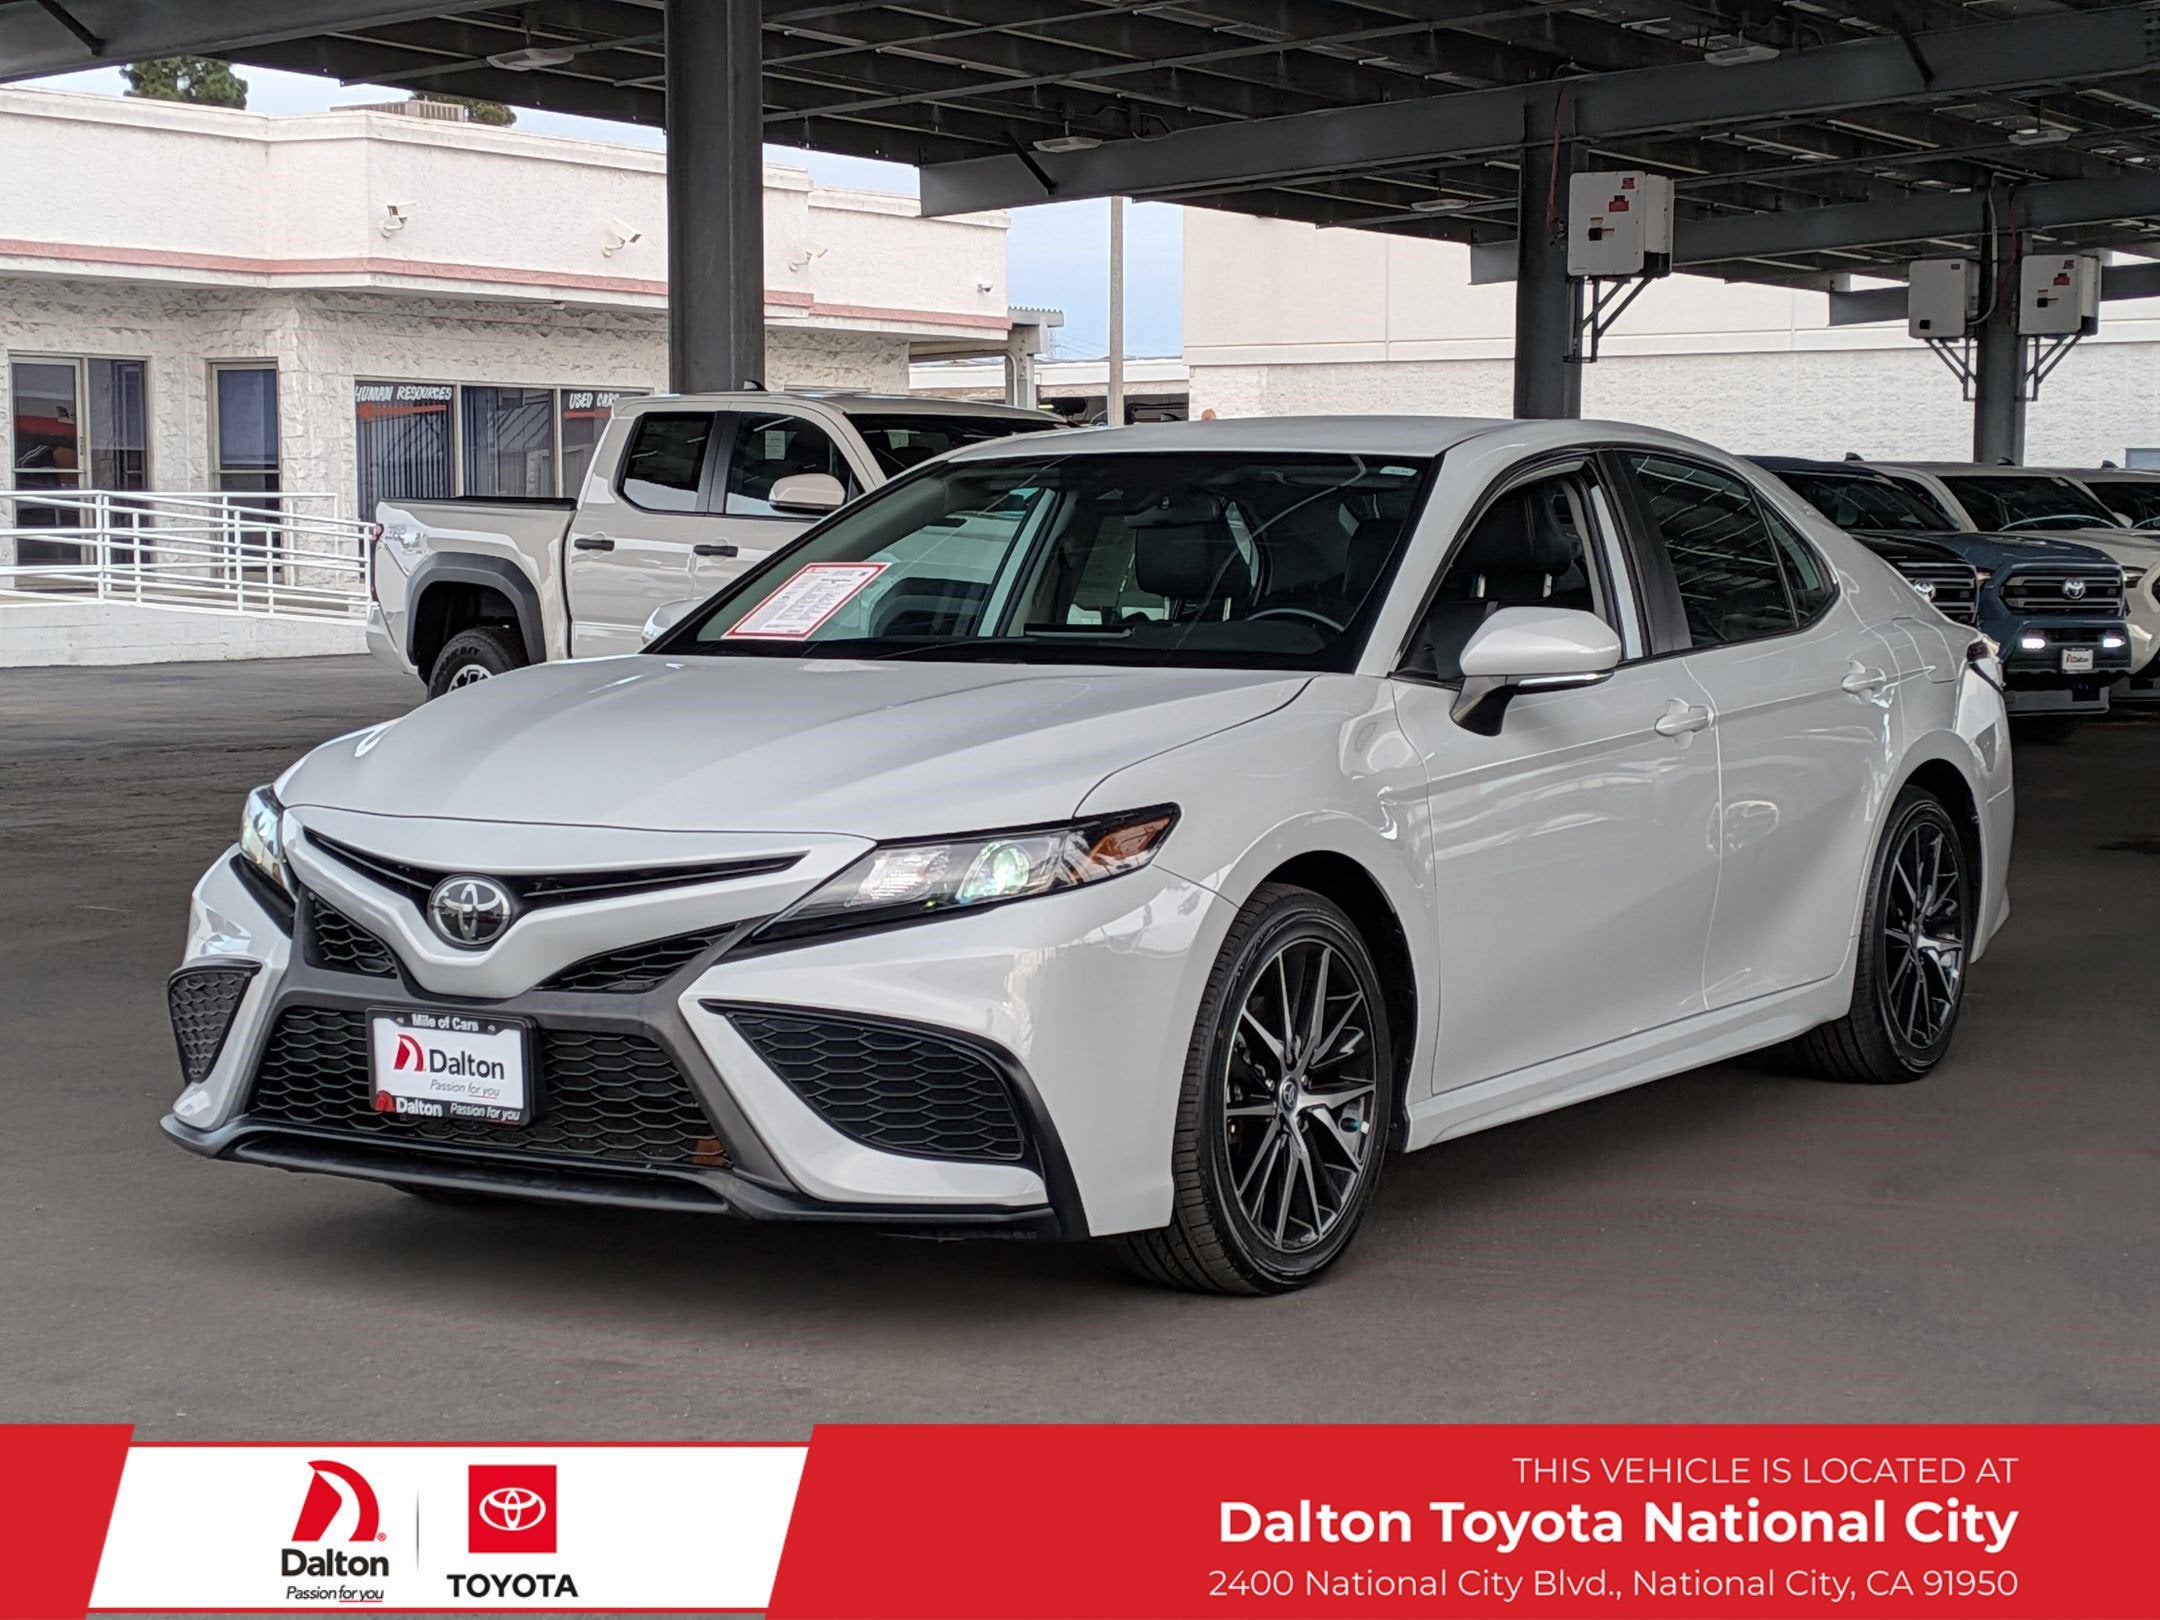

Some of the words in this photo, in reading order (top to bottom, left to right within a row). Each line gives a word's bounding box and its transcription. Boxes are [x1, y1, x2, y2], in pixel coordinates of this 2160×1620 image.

[354, 386, 394, 402] HUMAN
[396, 386, 452, 401] RESOURCES
[569, 392, 594, 409] USED
[411, 1013, 436, 1028] Mile
[438, 1016, 450, 1029] of
[451, 1017, 479, 1031] Cars
[429, 1049, 505, 1080] Dalton
[430, 1079, 466, 1092] Passion
[467, 1083, 481, 1095] for
[482, 1087, 501, 1098] you
[395, 1097, 443, 1117] Dalton
[450, 1102, 486, 1118] Passion
[486, 1106, 500, 1119] for
[501, 1109, 521, 1121] you
